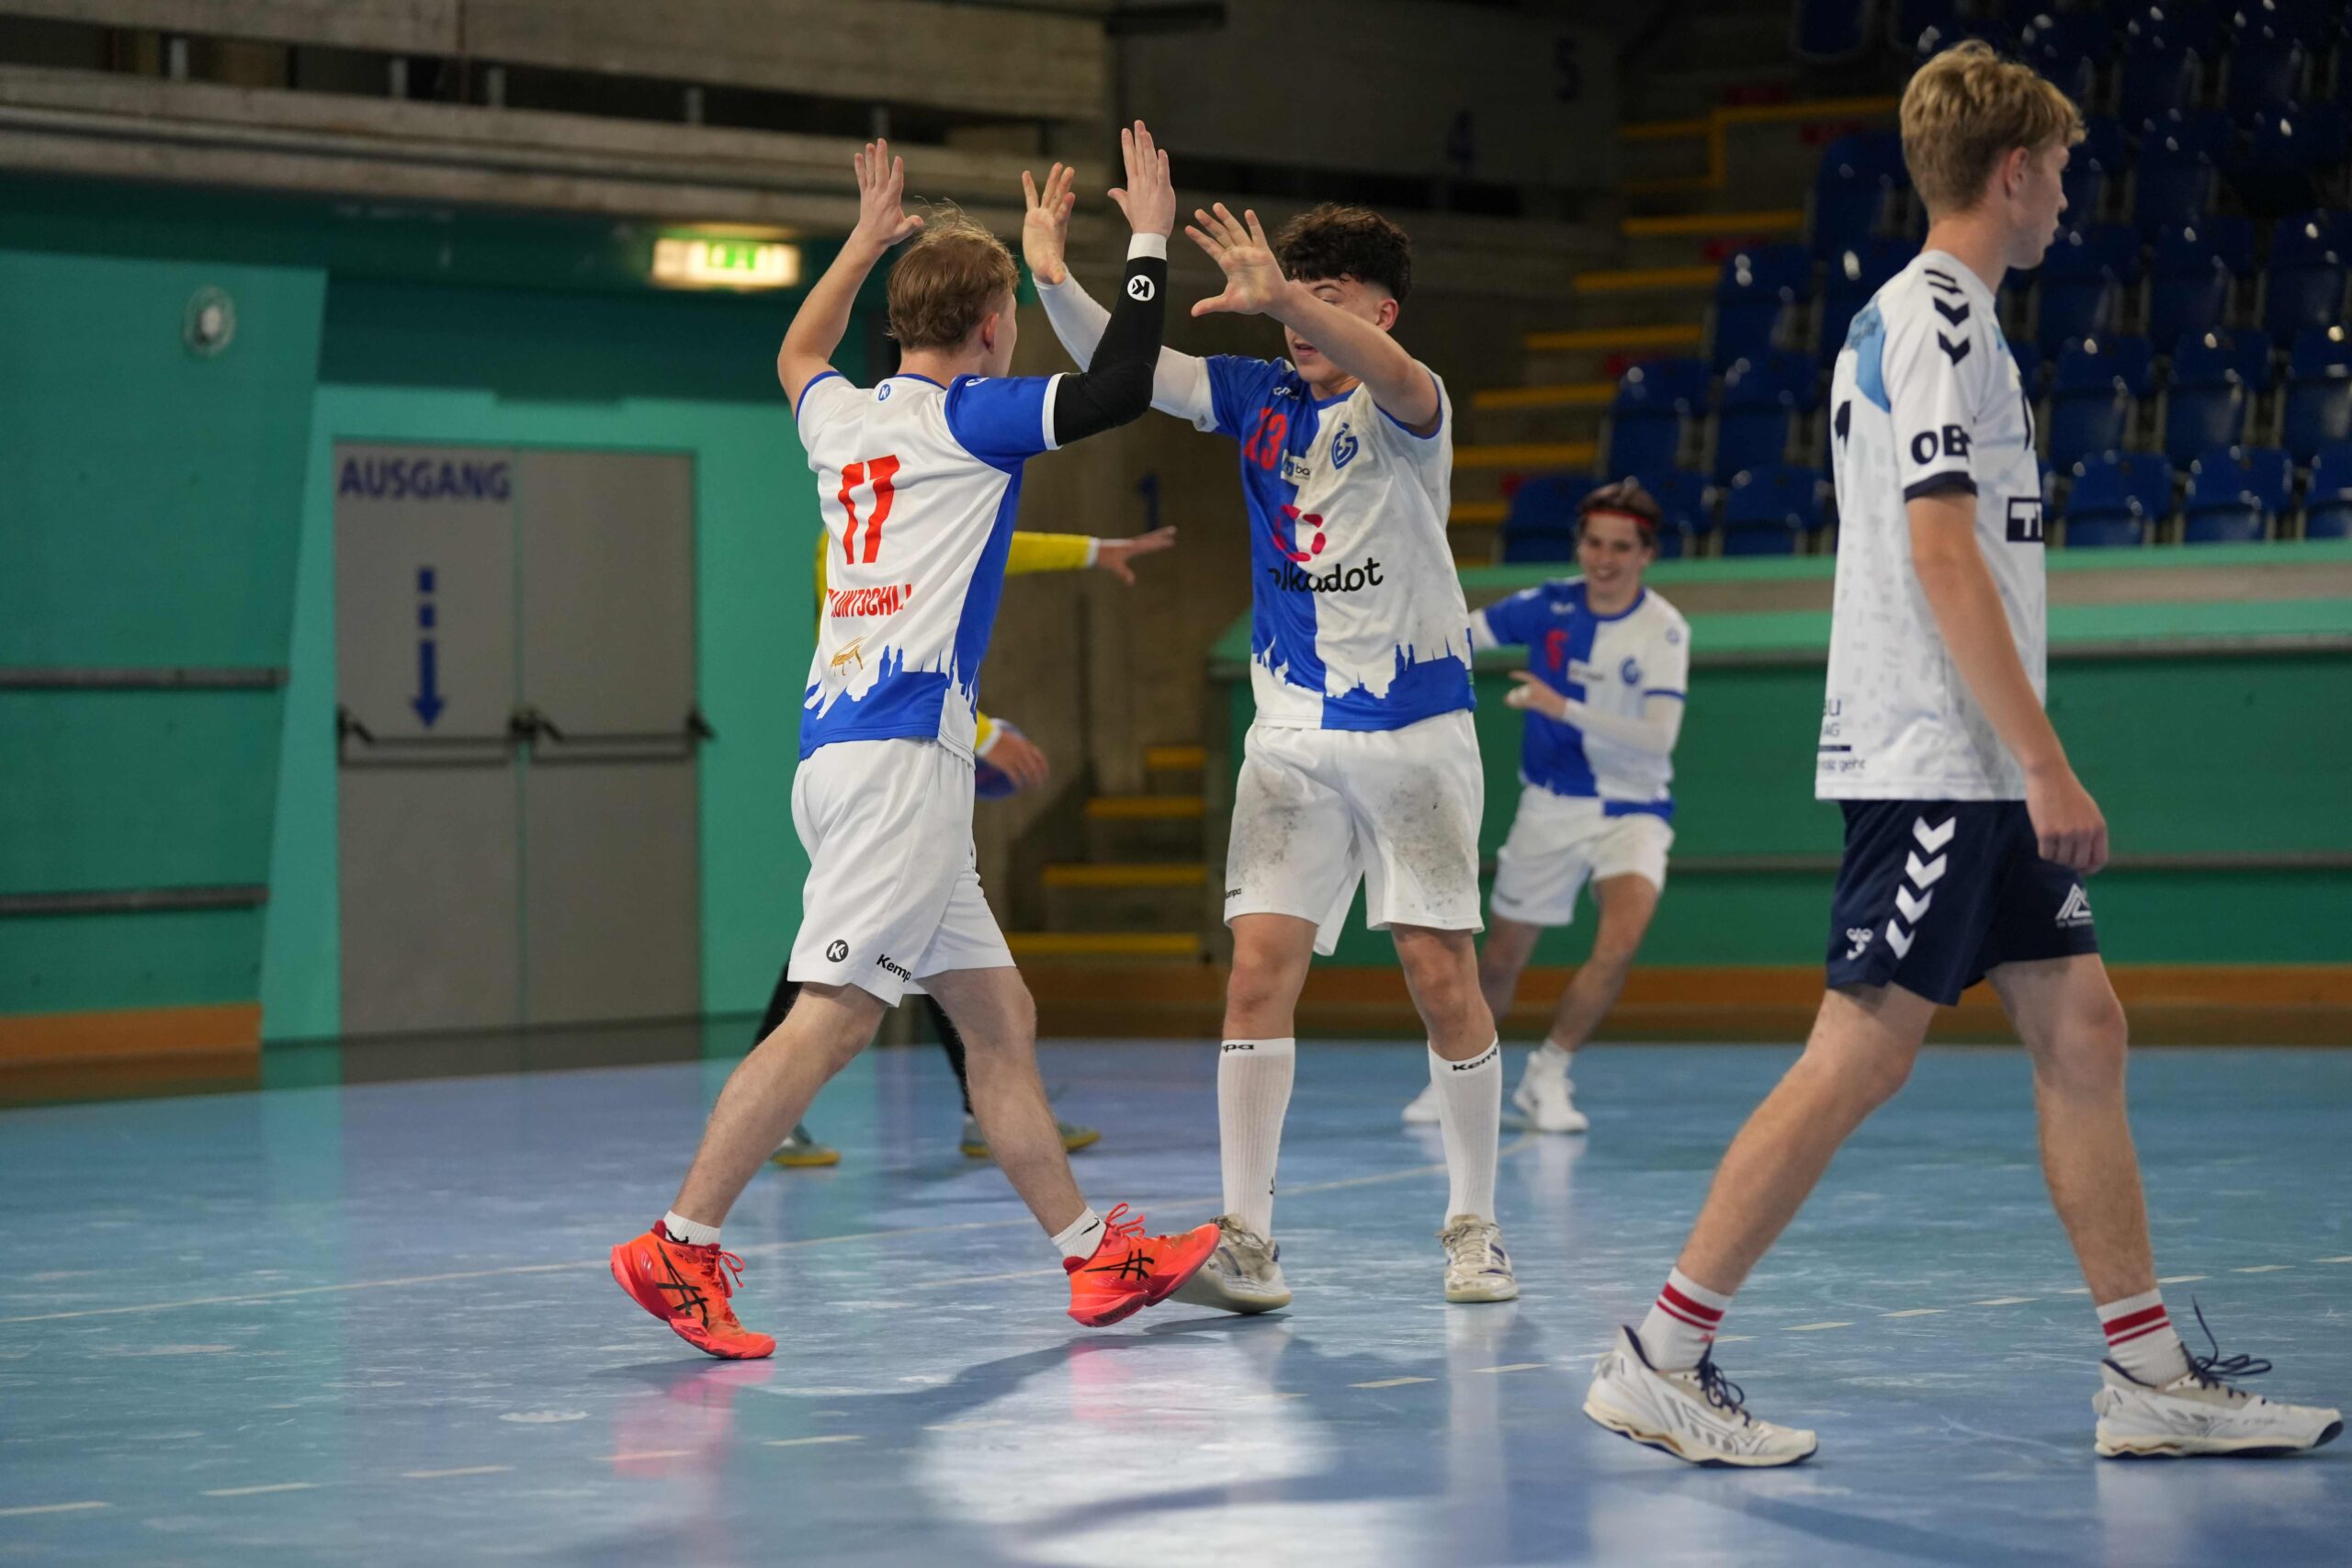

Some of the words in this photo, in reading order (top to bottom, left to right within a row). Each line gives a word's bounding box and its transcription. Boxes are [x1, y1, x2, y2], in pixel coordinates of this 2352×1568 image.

[1911, 424, 1973, 465] OB
[339, 458, 511, 500] AUSGANG
[838, 455, 900, 565] 17
[876, 953, 912, 983] Kemp
